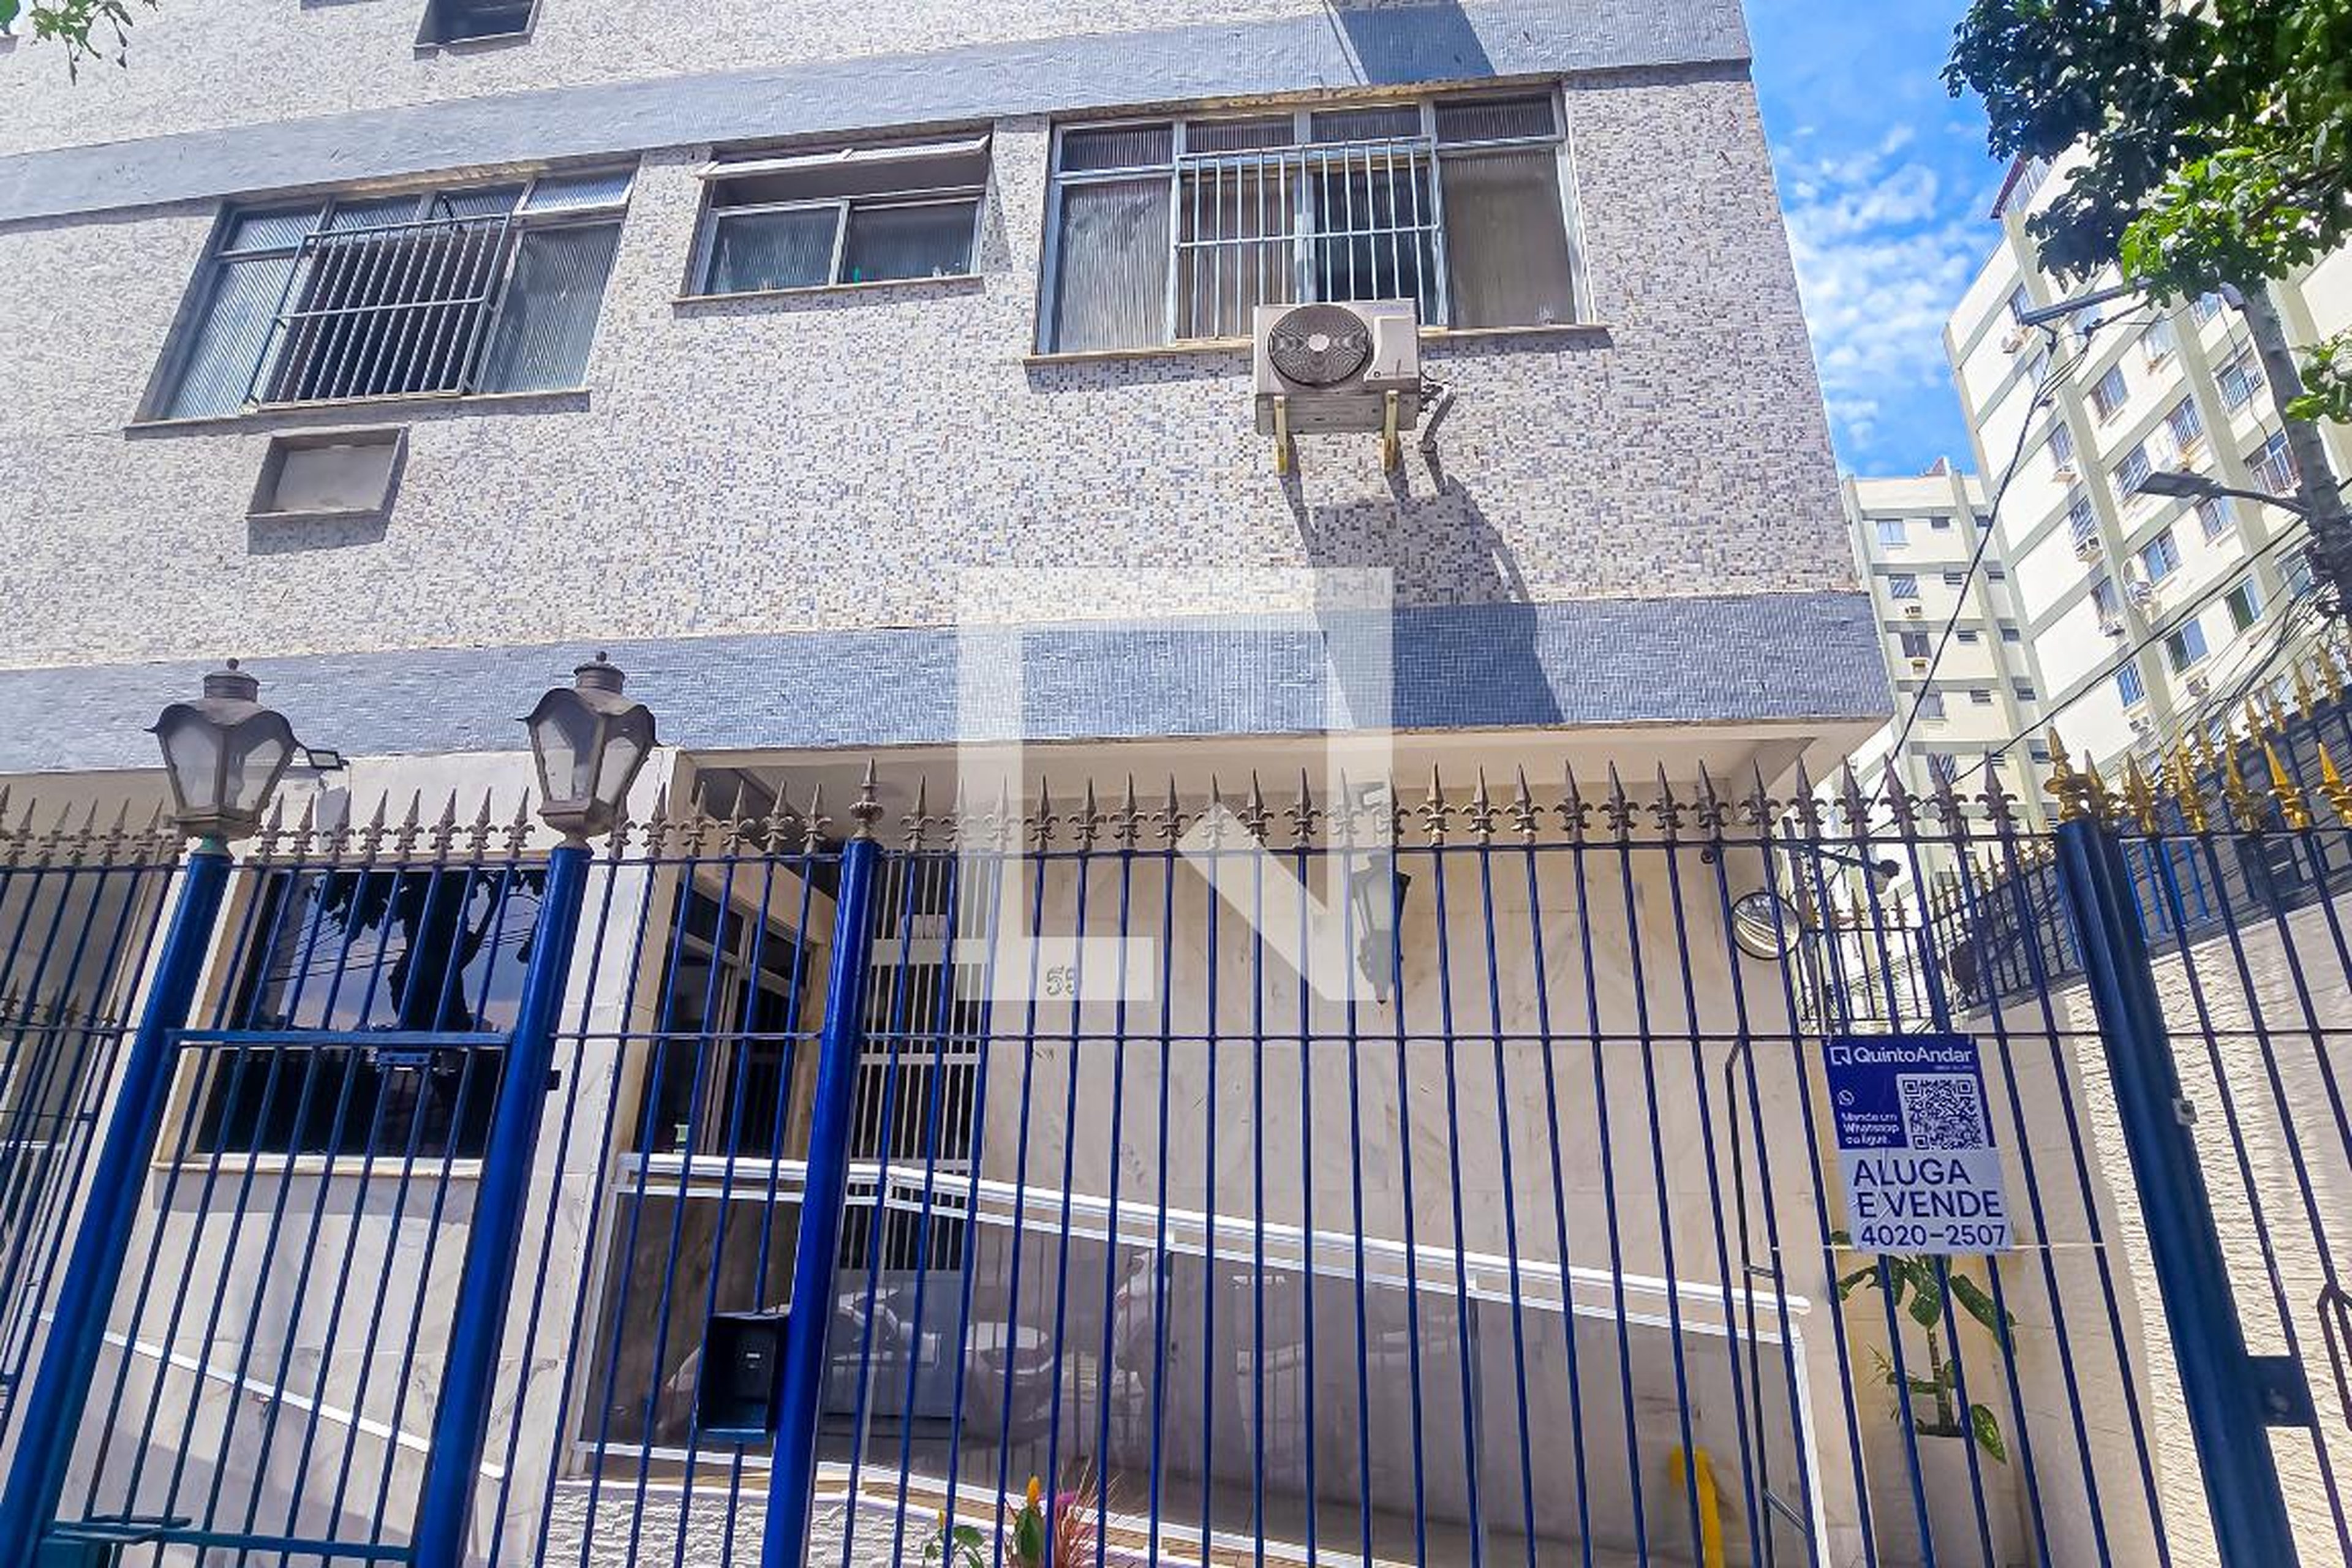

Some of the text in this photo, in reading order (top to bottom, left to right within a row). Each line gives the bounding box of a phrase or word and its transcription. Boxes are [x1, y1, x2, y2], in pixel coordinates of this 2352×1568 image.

[1853, 1046, 1972, 1063] QuintoAndar
[1853, 1158, 1972, 1186] ALUGA
[1857, 1191, 2003, 1218] E VENDE
[1861, 1224, 2005, 1246] 4020-2507
